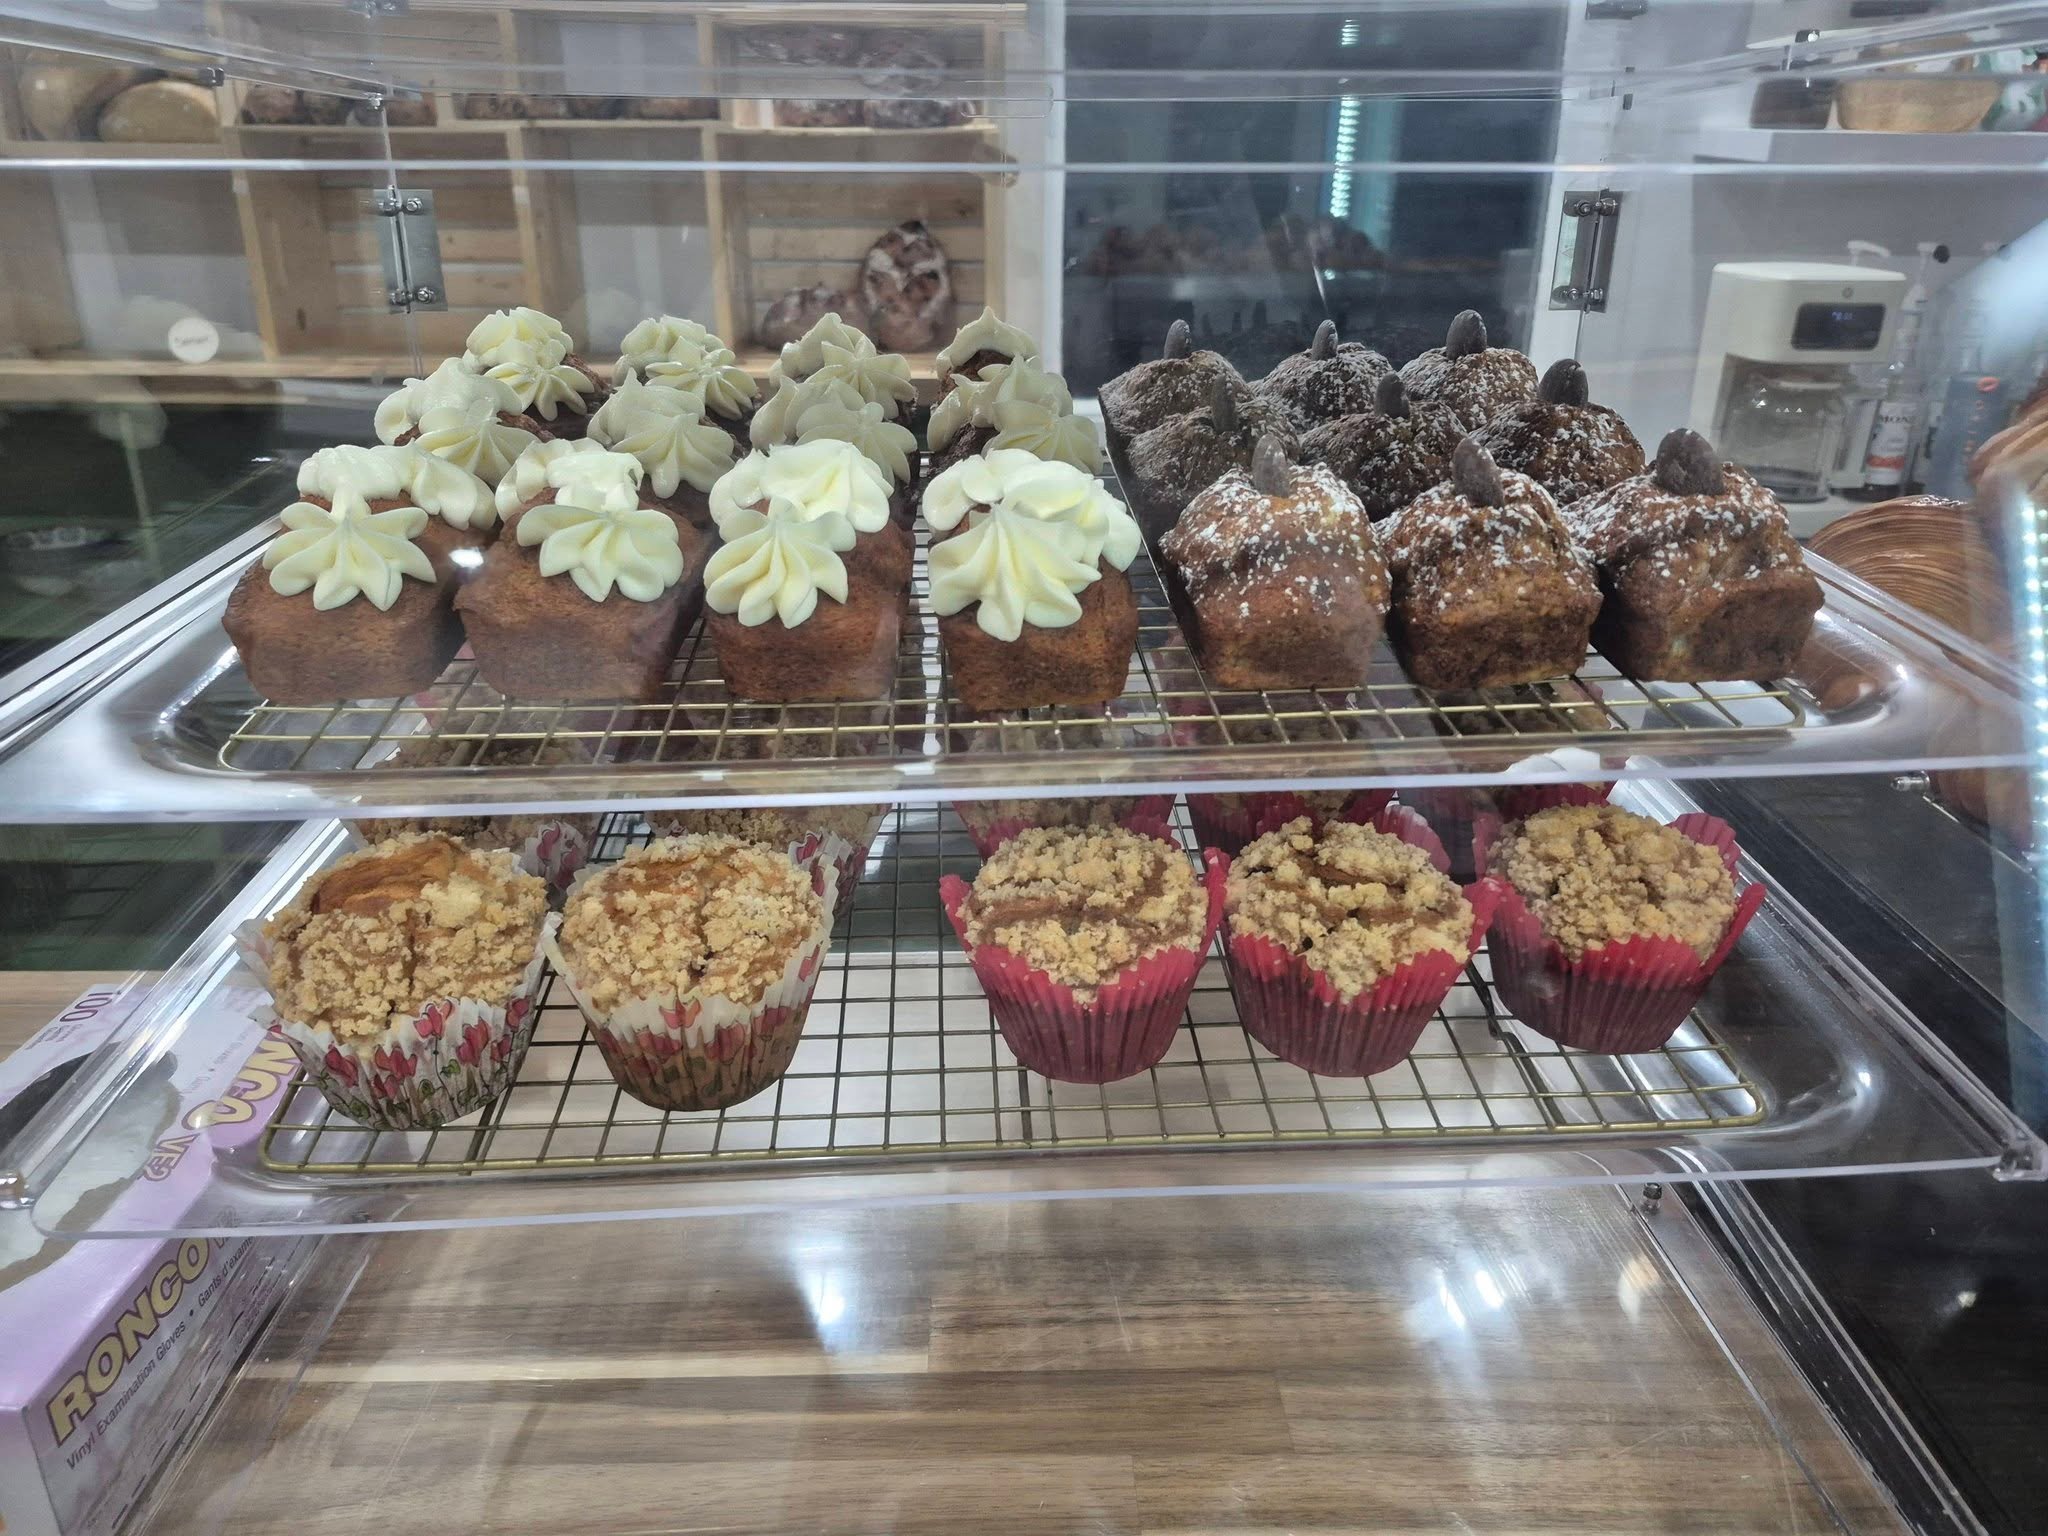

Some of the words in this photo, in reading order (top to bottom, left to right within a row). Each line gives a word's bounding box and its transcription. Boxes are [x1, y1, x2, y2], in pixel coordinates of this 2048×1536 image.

[181, 1031, 304, 1131] NCO
[46, 1236, 210, 1448] RONCO
[66, 1432, 96, 1470] Vinyl
[97, 1359, 156, 1437] Examination
[155, 1321, 187, 1361] Gloves
[198, 1275, 222, 1307] Gants
[222, 1236, 257, 1278] d'exame
